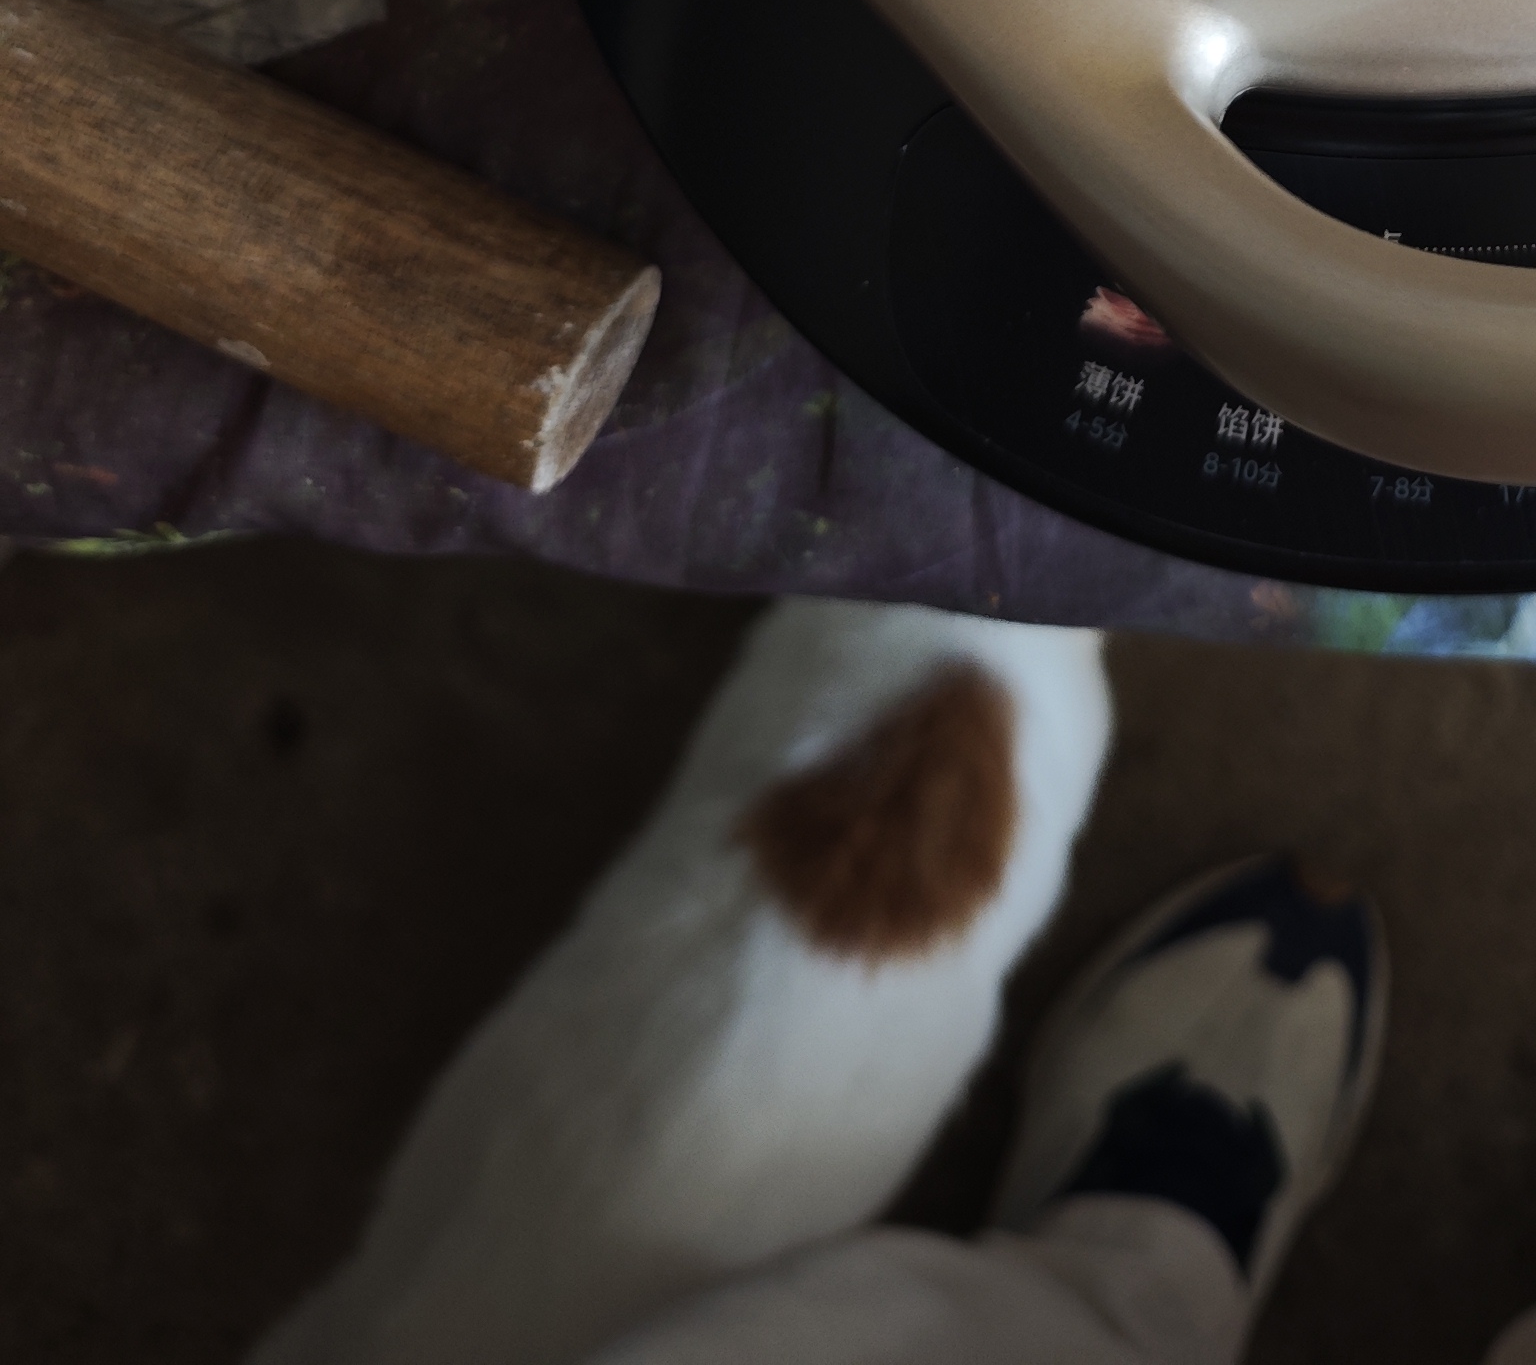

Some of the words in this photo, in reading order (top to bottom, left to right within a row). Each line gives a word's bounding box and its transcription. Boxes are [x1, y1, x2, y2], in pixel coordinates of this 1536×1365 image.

[1074, 360, 1146, 412] 薄饼
[1065, 409, 1129, 449] 4-5分
[1217, 401, 1285, 447] 馅饼
[1202, 451, 1283, 488] 8-10分
[1370, 474, 1434, 502] 7-8分
